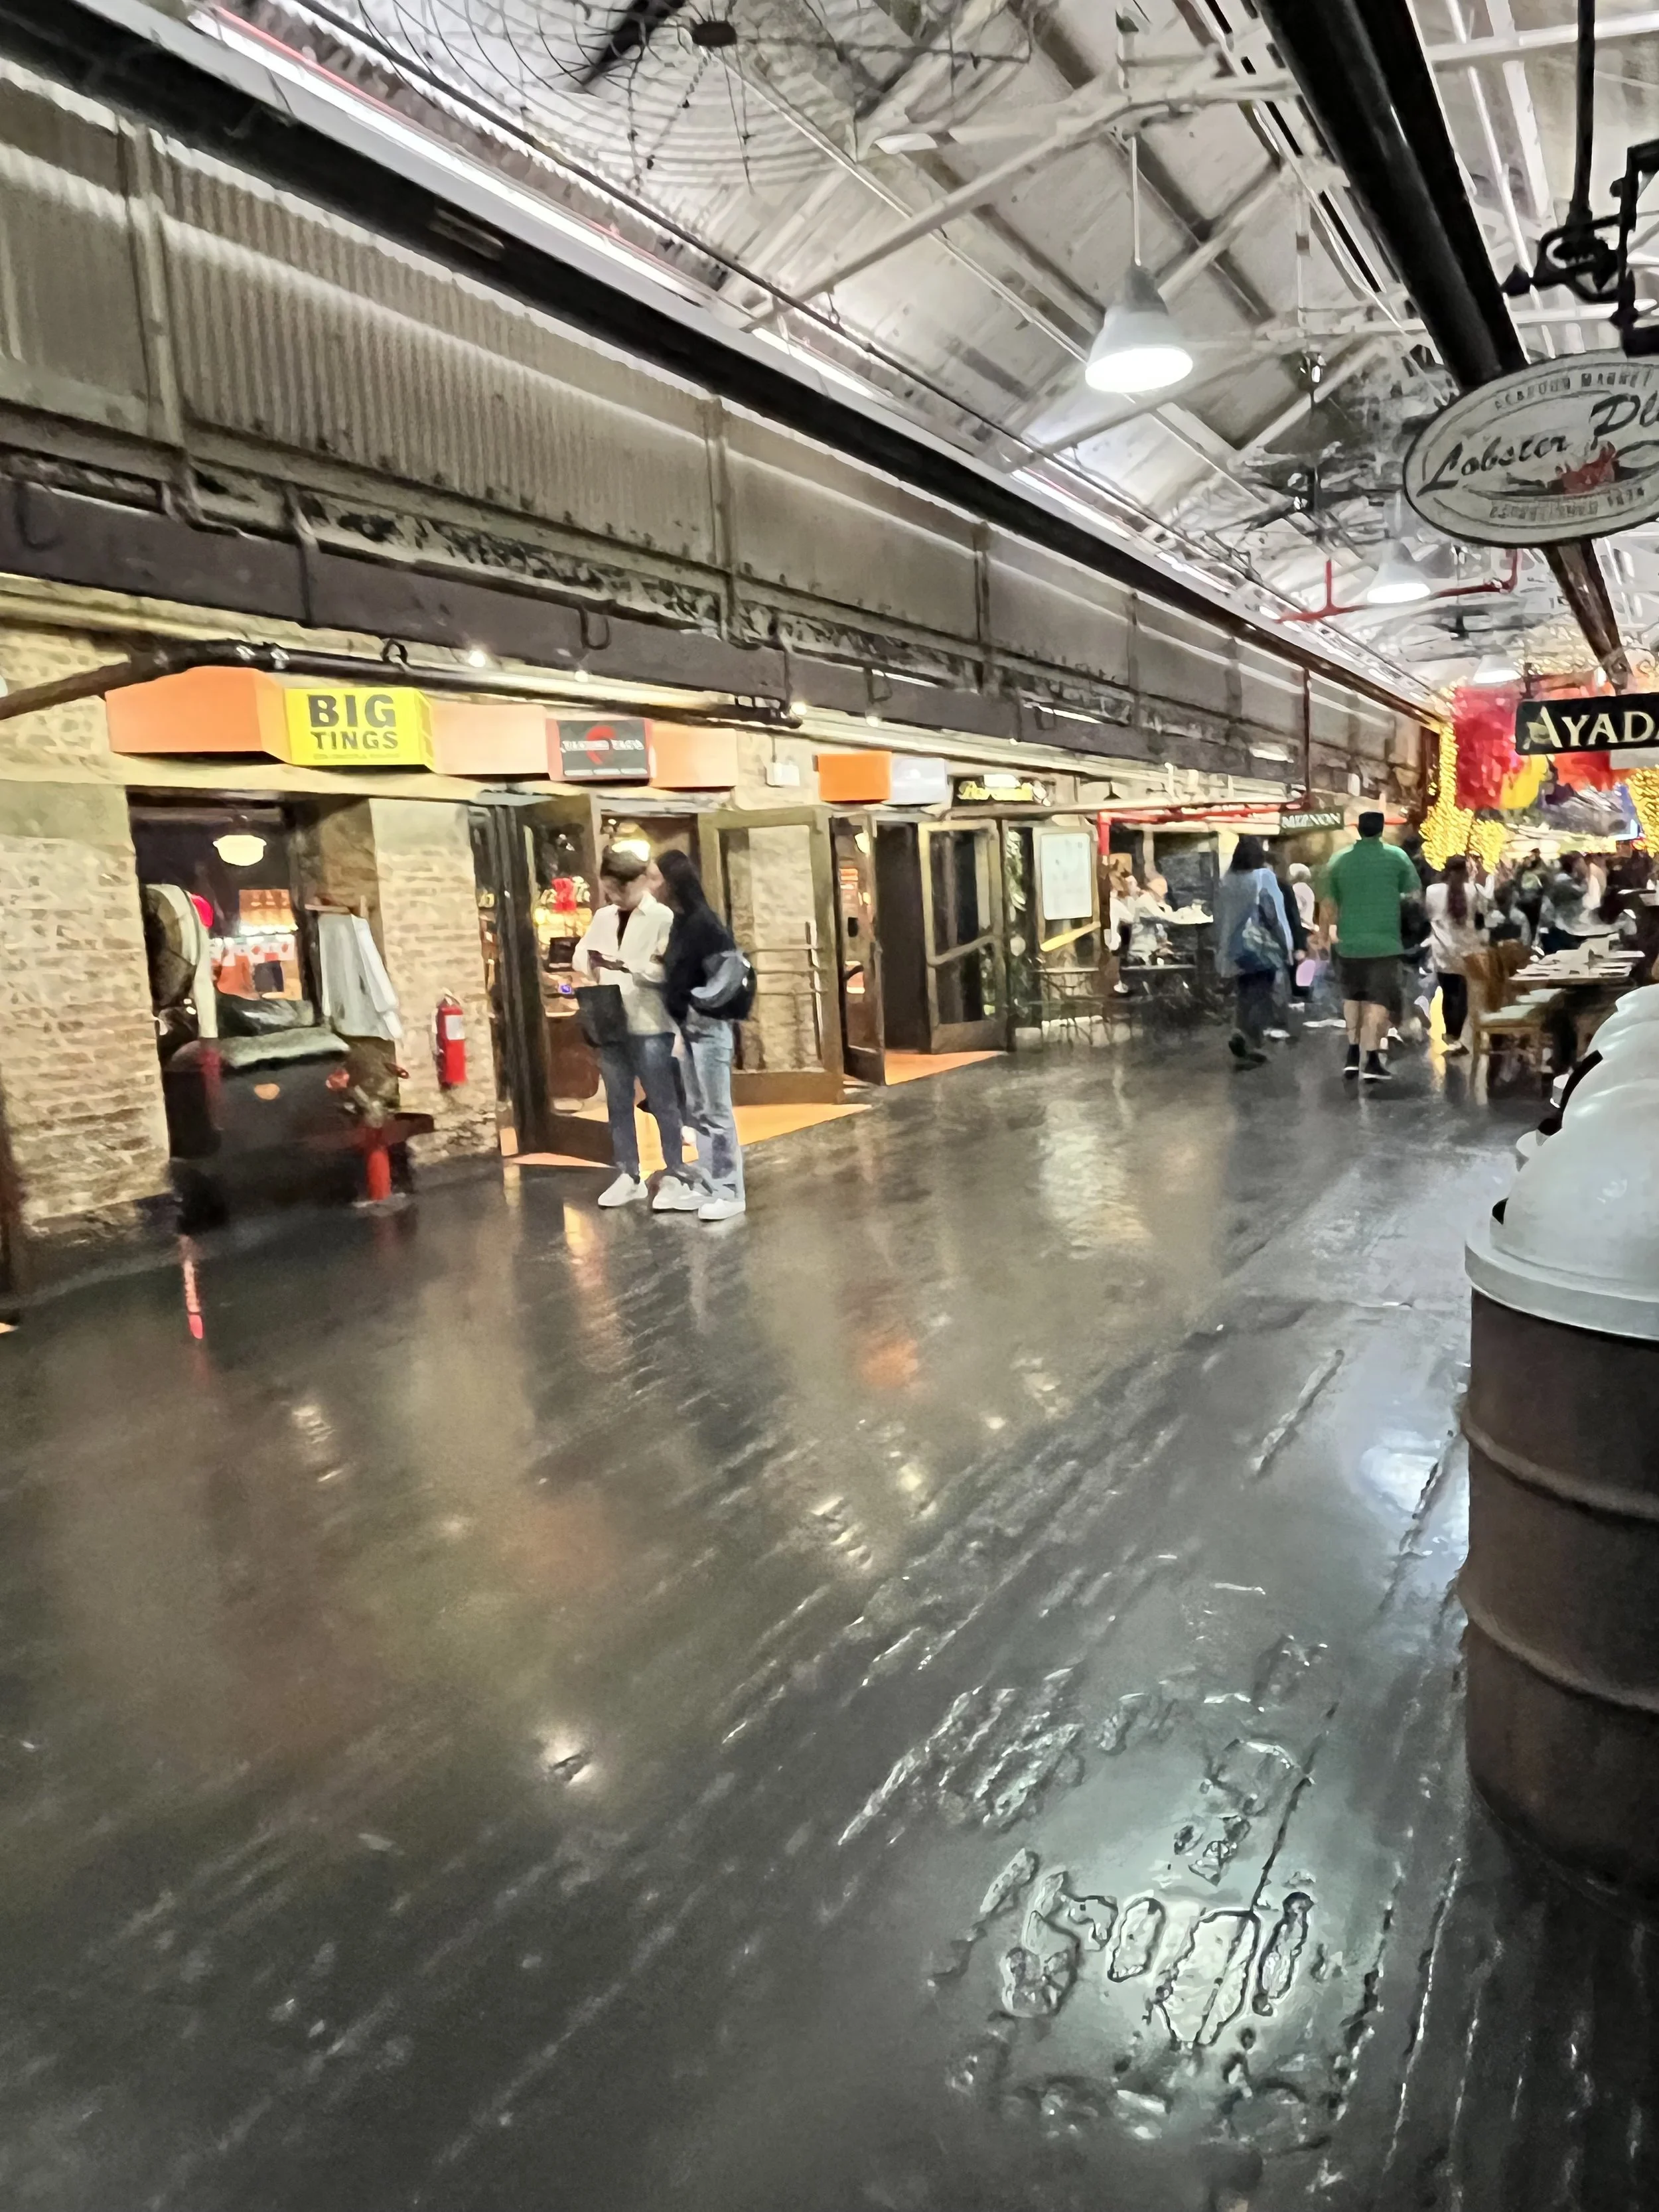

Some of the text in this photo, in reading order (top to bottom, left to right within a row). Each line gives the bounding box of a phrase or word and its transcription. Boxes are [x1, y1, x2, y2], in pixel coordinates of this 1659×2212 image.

[1589, 390, 1659, 450] Pl
[307, 694, 396, 727] BIG
[1523, 705, 1659, 750] AYAD
[311, 731, 398, 749] TINGS
